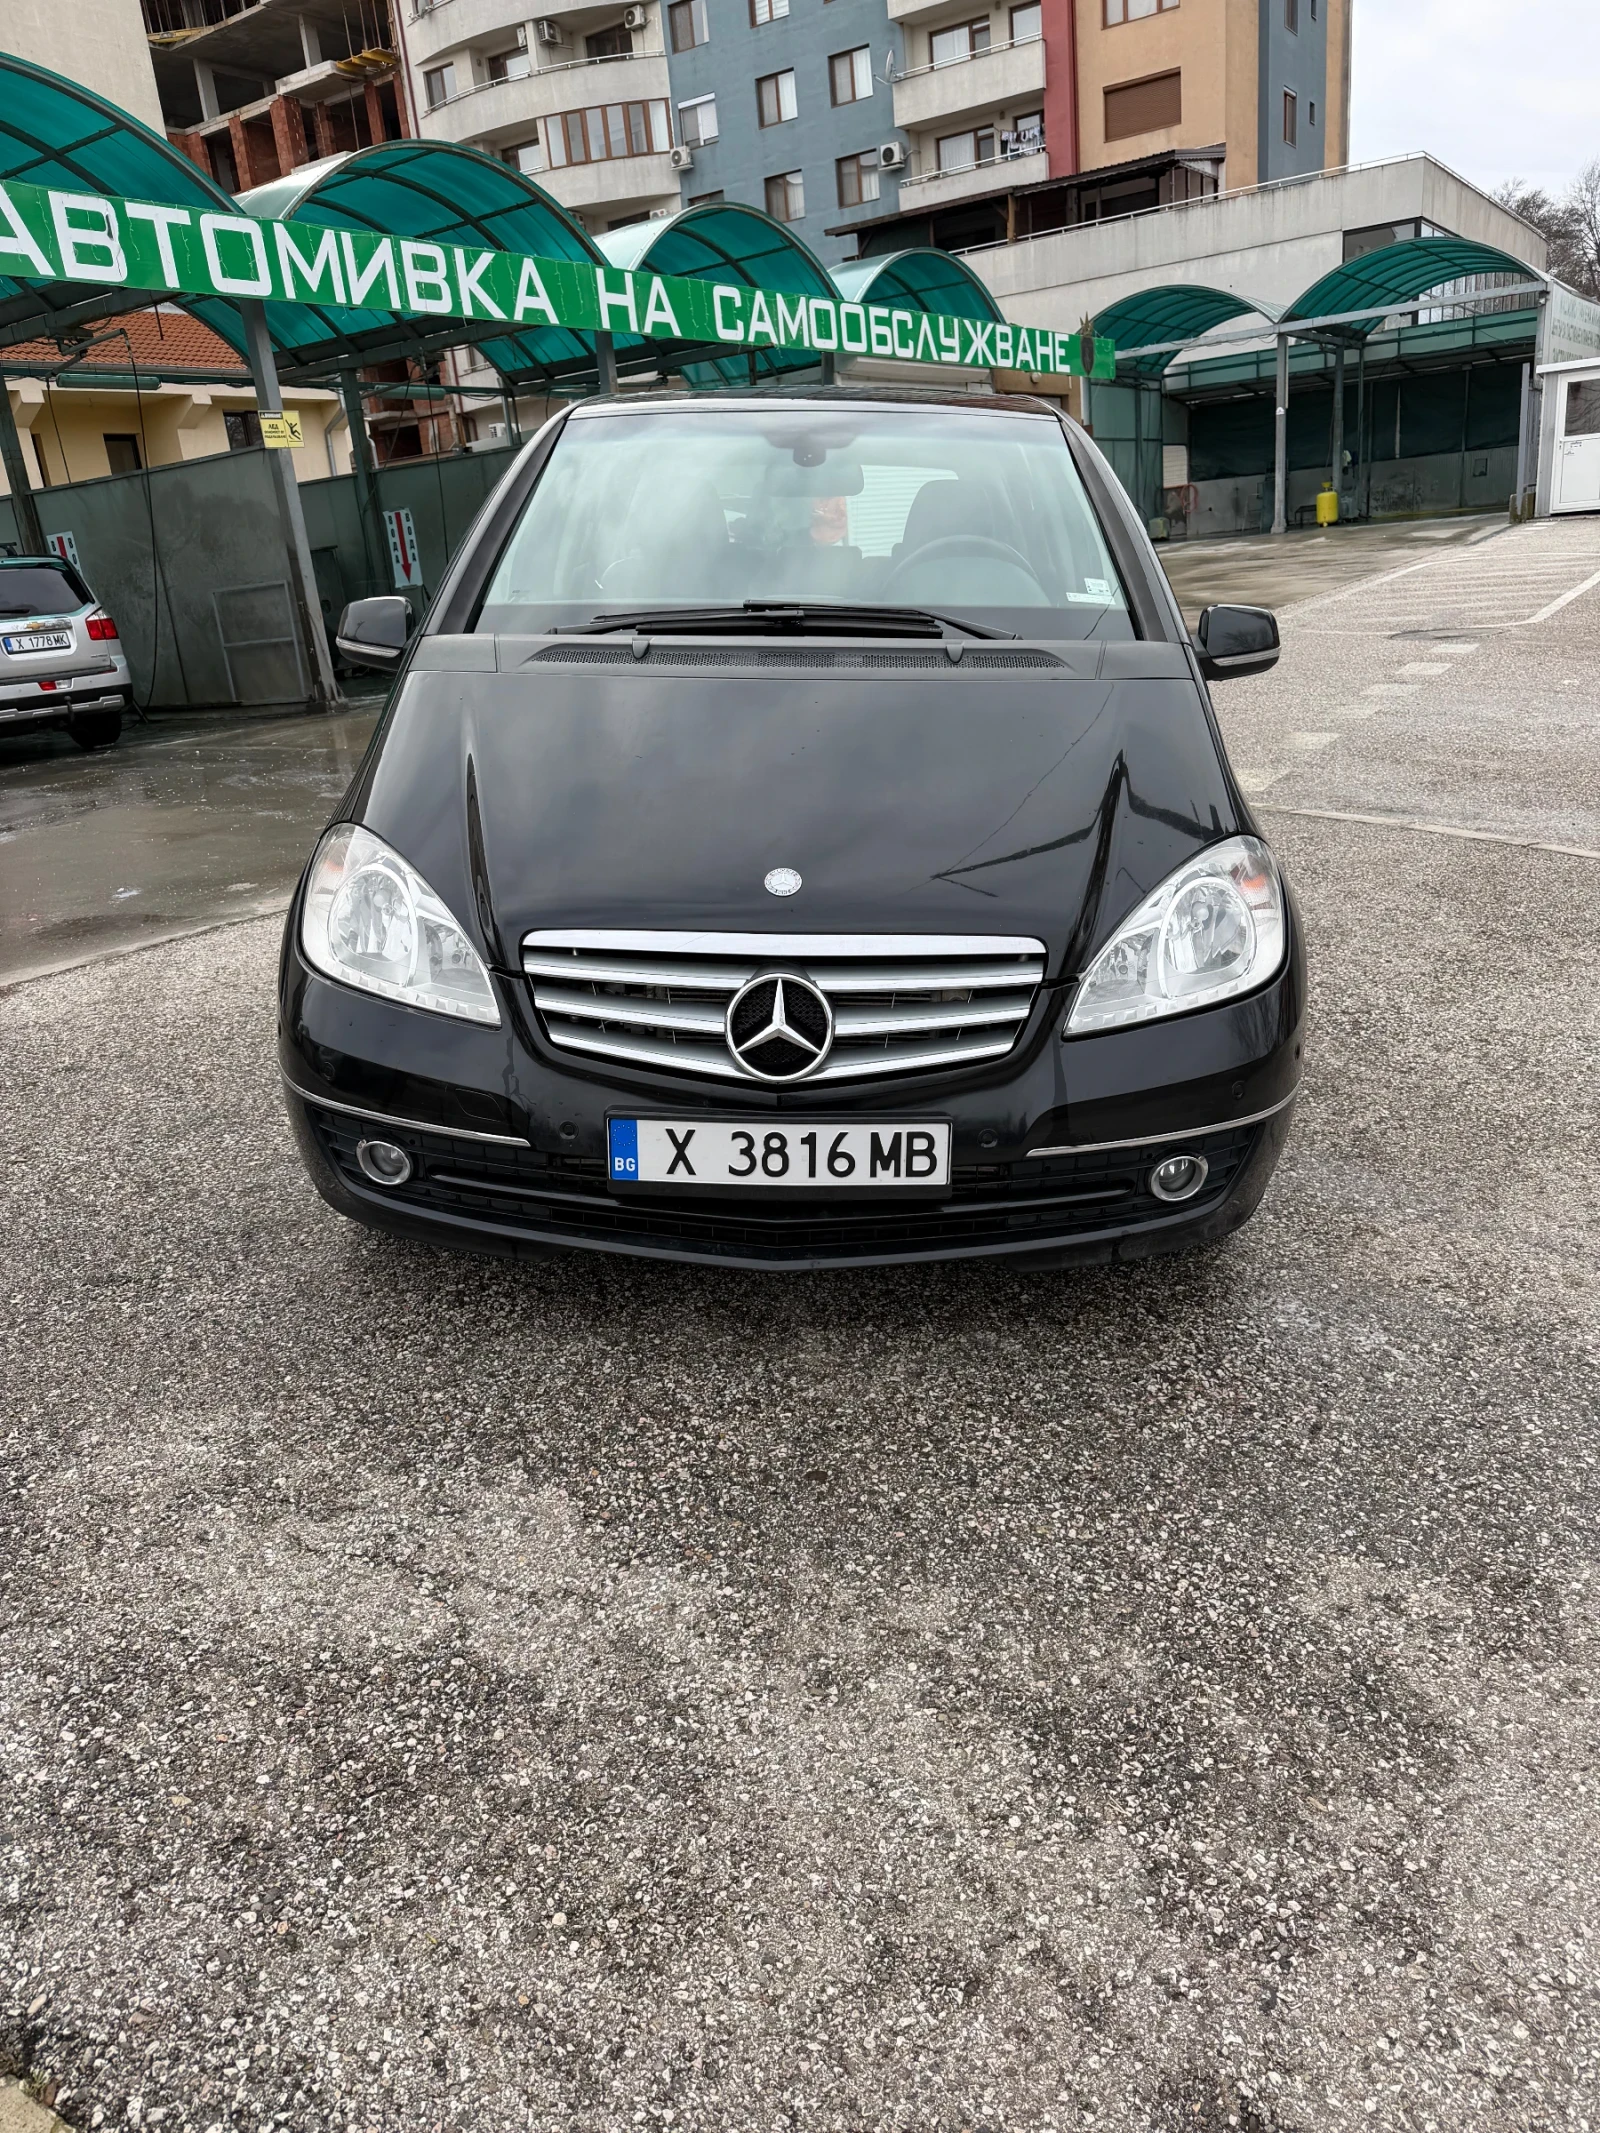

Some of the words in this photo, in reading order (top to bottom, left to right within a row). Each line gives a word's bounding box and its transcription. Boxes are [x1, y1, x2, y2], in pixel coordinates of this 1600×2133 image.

[596, 268, 681, 337] НА
[712, 285, 1071, 373] САМООБСЛУЖВАНЕ
[16, 638, 25, 650] X
[29, 635, 53, 648] 1778
[614, 1157, 636, 1172] BG
[665, 1127, 697, 1176] X
[728, 1130, 856, 1178] 3816
[869, 1130, 938, 1179] MB
